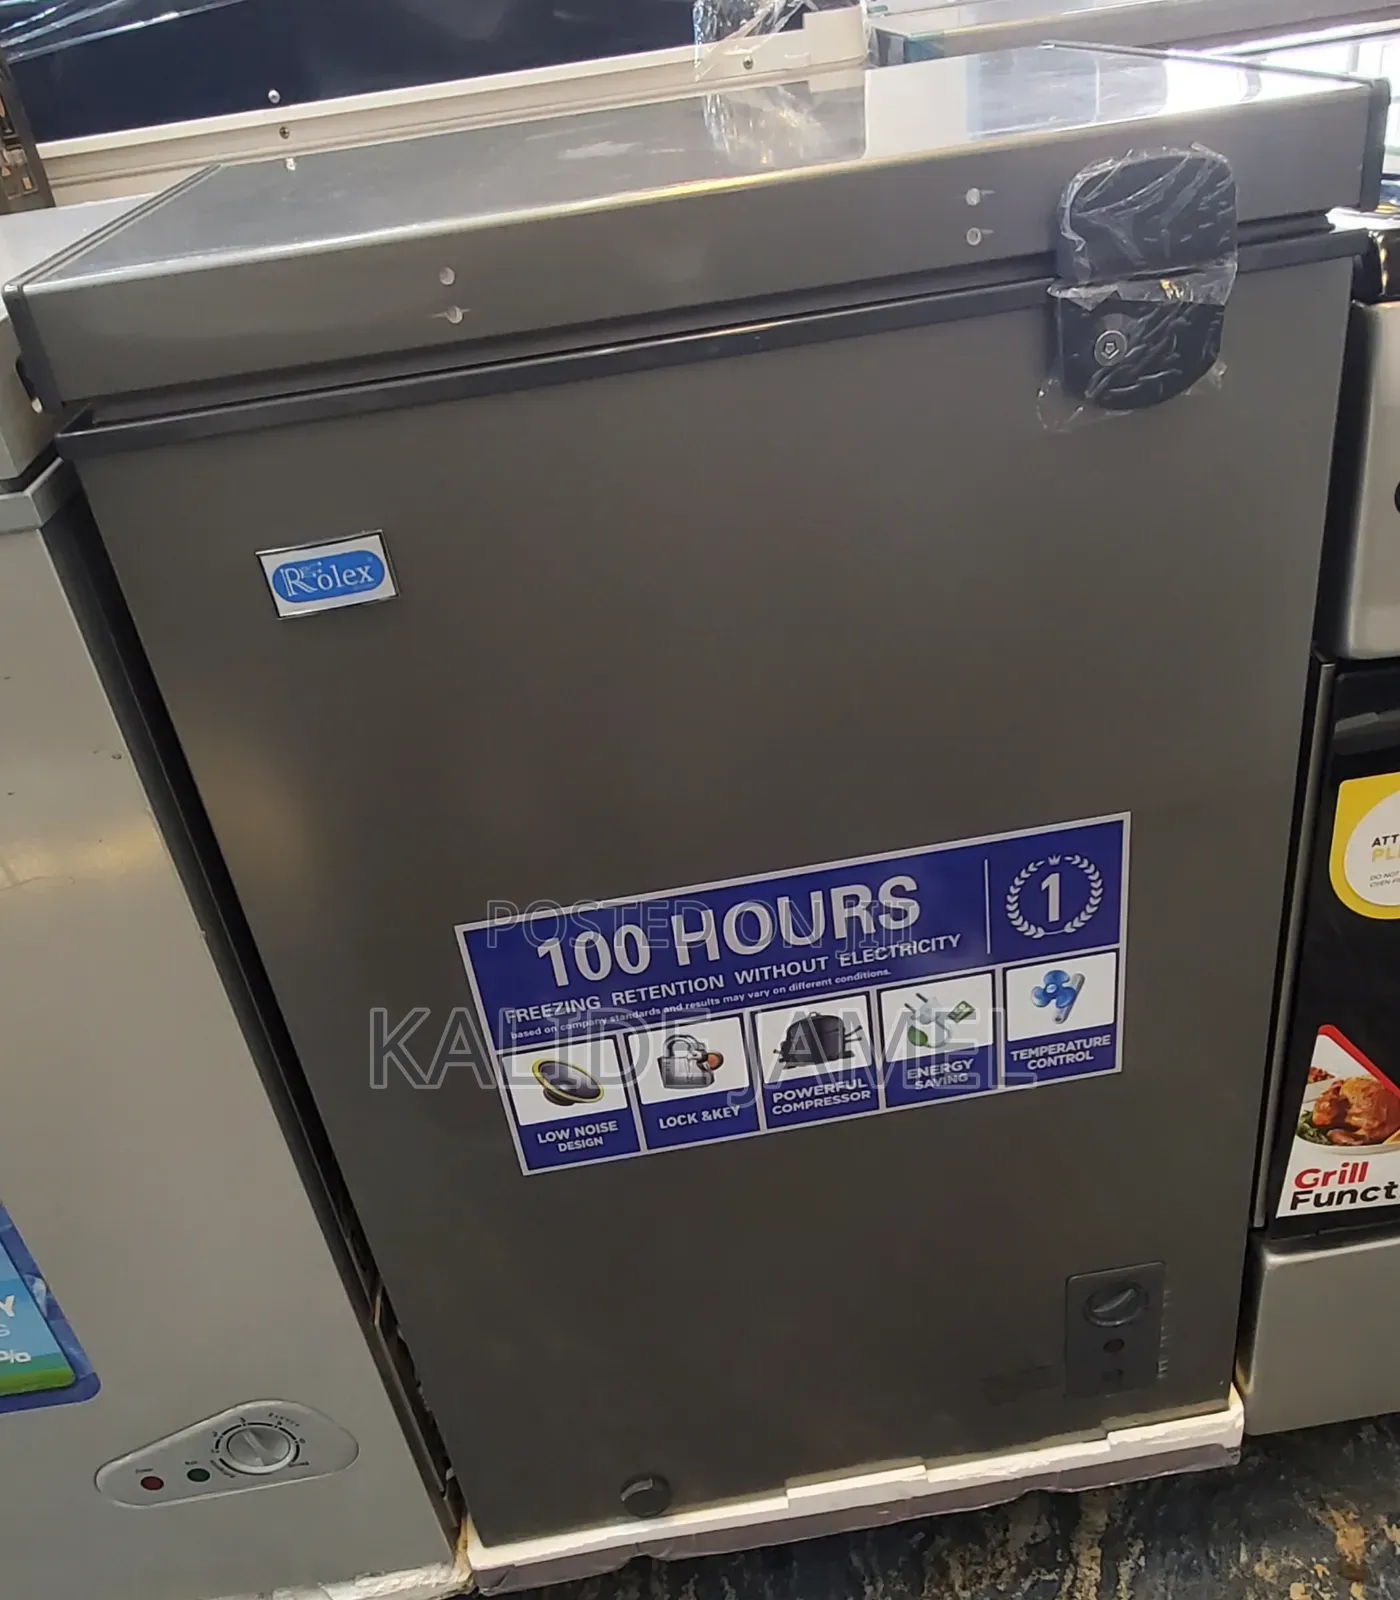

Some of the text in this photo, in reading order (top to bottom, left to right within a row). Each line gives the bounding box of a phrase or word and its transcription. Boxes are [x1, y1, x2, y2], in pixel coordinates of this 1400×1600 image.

[280, 563, 375, 597] Rolex
[1041, 872, 1060, 922] 1
[536, 874, 920, 987] 100 HOURS
[504, 933, 962, 1024] FREEZING RETENTION WITHOUT ELECTRICITY
[510, 968, 892, 1040] based on company standards and results may vary on different conditions.
[1010, 1035, 1112, 1061] TEMPERATURE
[1027, 1051, 1095, 1070] CONTROL
[906, 1058, 974, 1080] ENERGY
[914, 1073, 969, 1090] SAVING
[771, 1090, 871, 1115] COMPRESSOR
[773, 1078, 869, 1103] POWERFUL
[536, 1120, 619, 1144] LOW NOISE
[659, 1113, 699, 1130] LOCK
[557, 1136, 604, 1152] DESIGN
[1294, 1161, 1369, 1189] Grill
[1290, 1181, 1400, 1211] Funct
